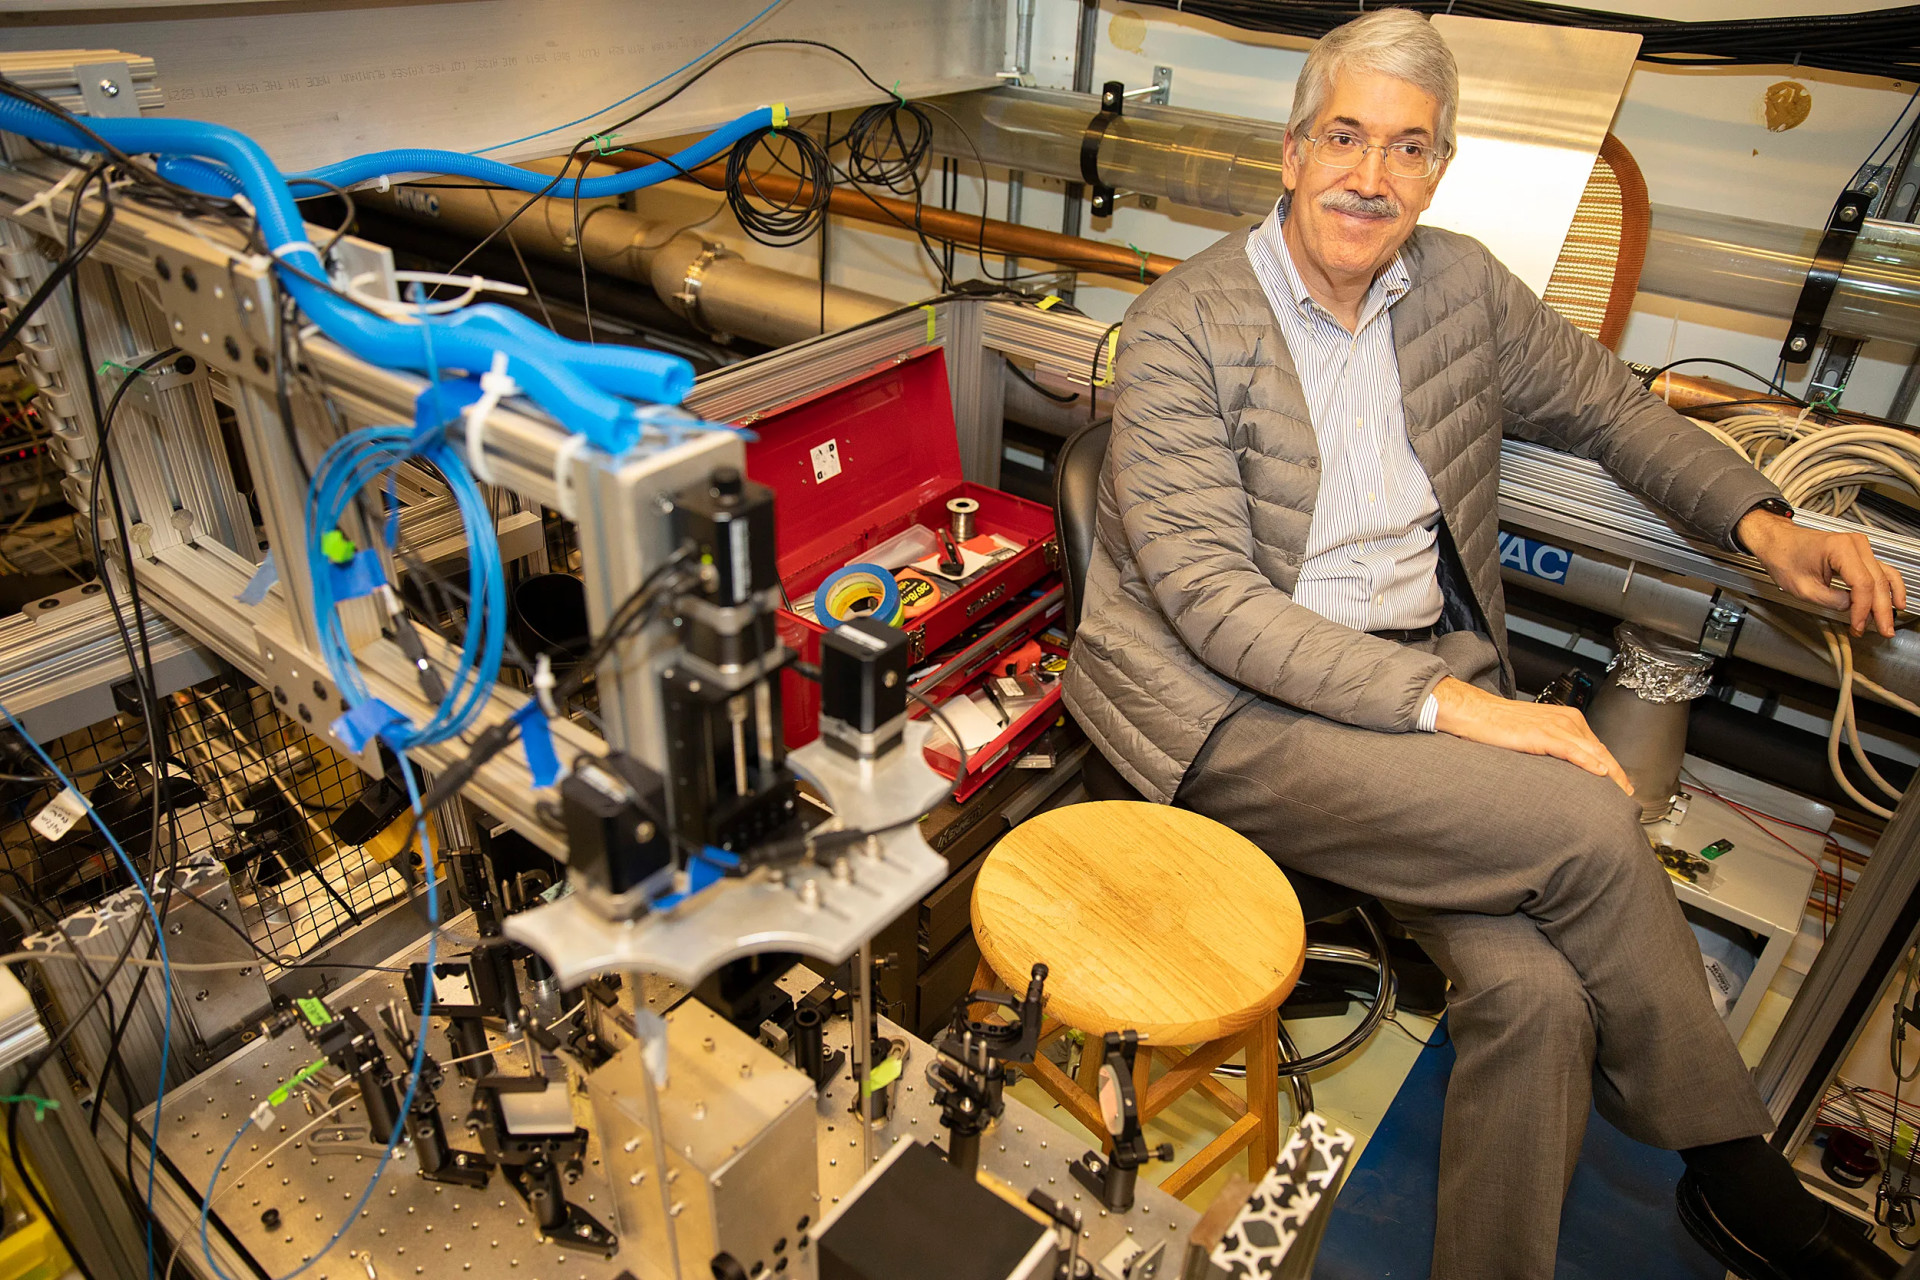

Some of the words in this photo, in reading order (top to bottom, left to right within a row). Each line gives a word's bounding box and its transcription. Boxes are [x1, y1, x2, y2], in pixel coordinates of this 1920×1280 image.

[306, 75, 331, 88] MADE
[339, 69, 386, 84] ALUMINUM
[237, 82, 259, 95] USA
[264, 79, 283, 92] THE
[287, 78, 300, 89] IN
